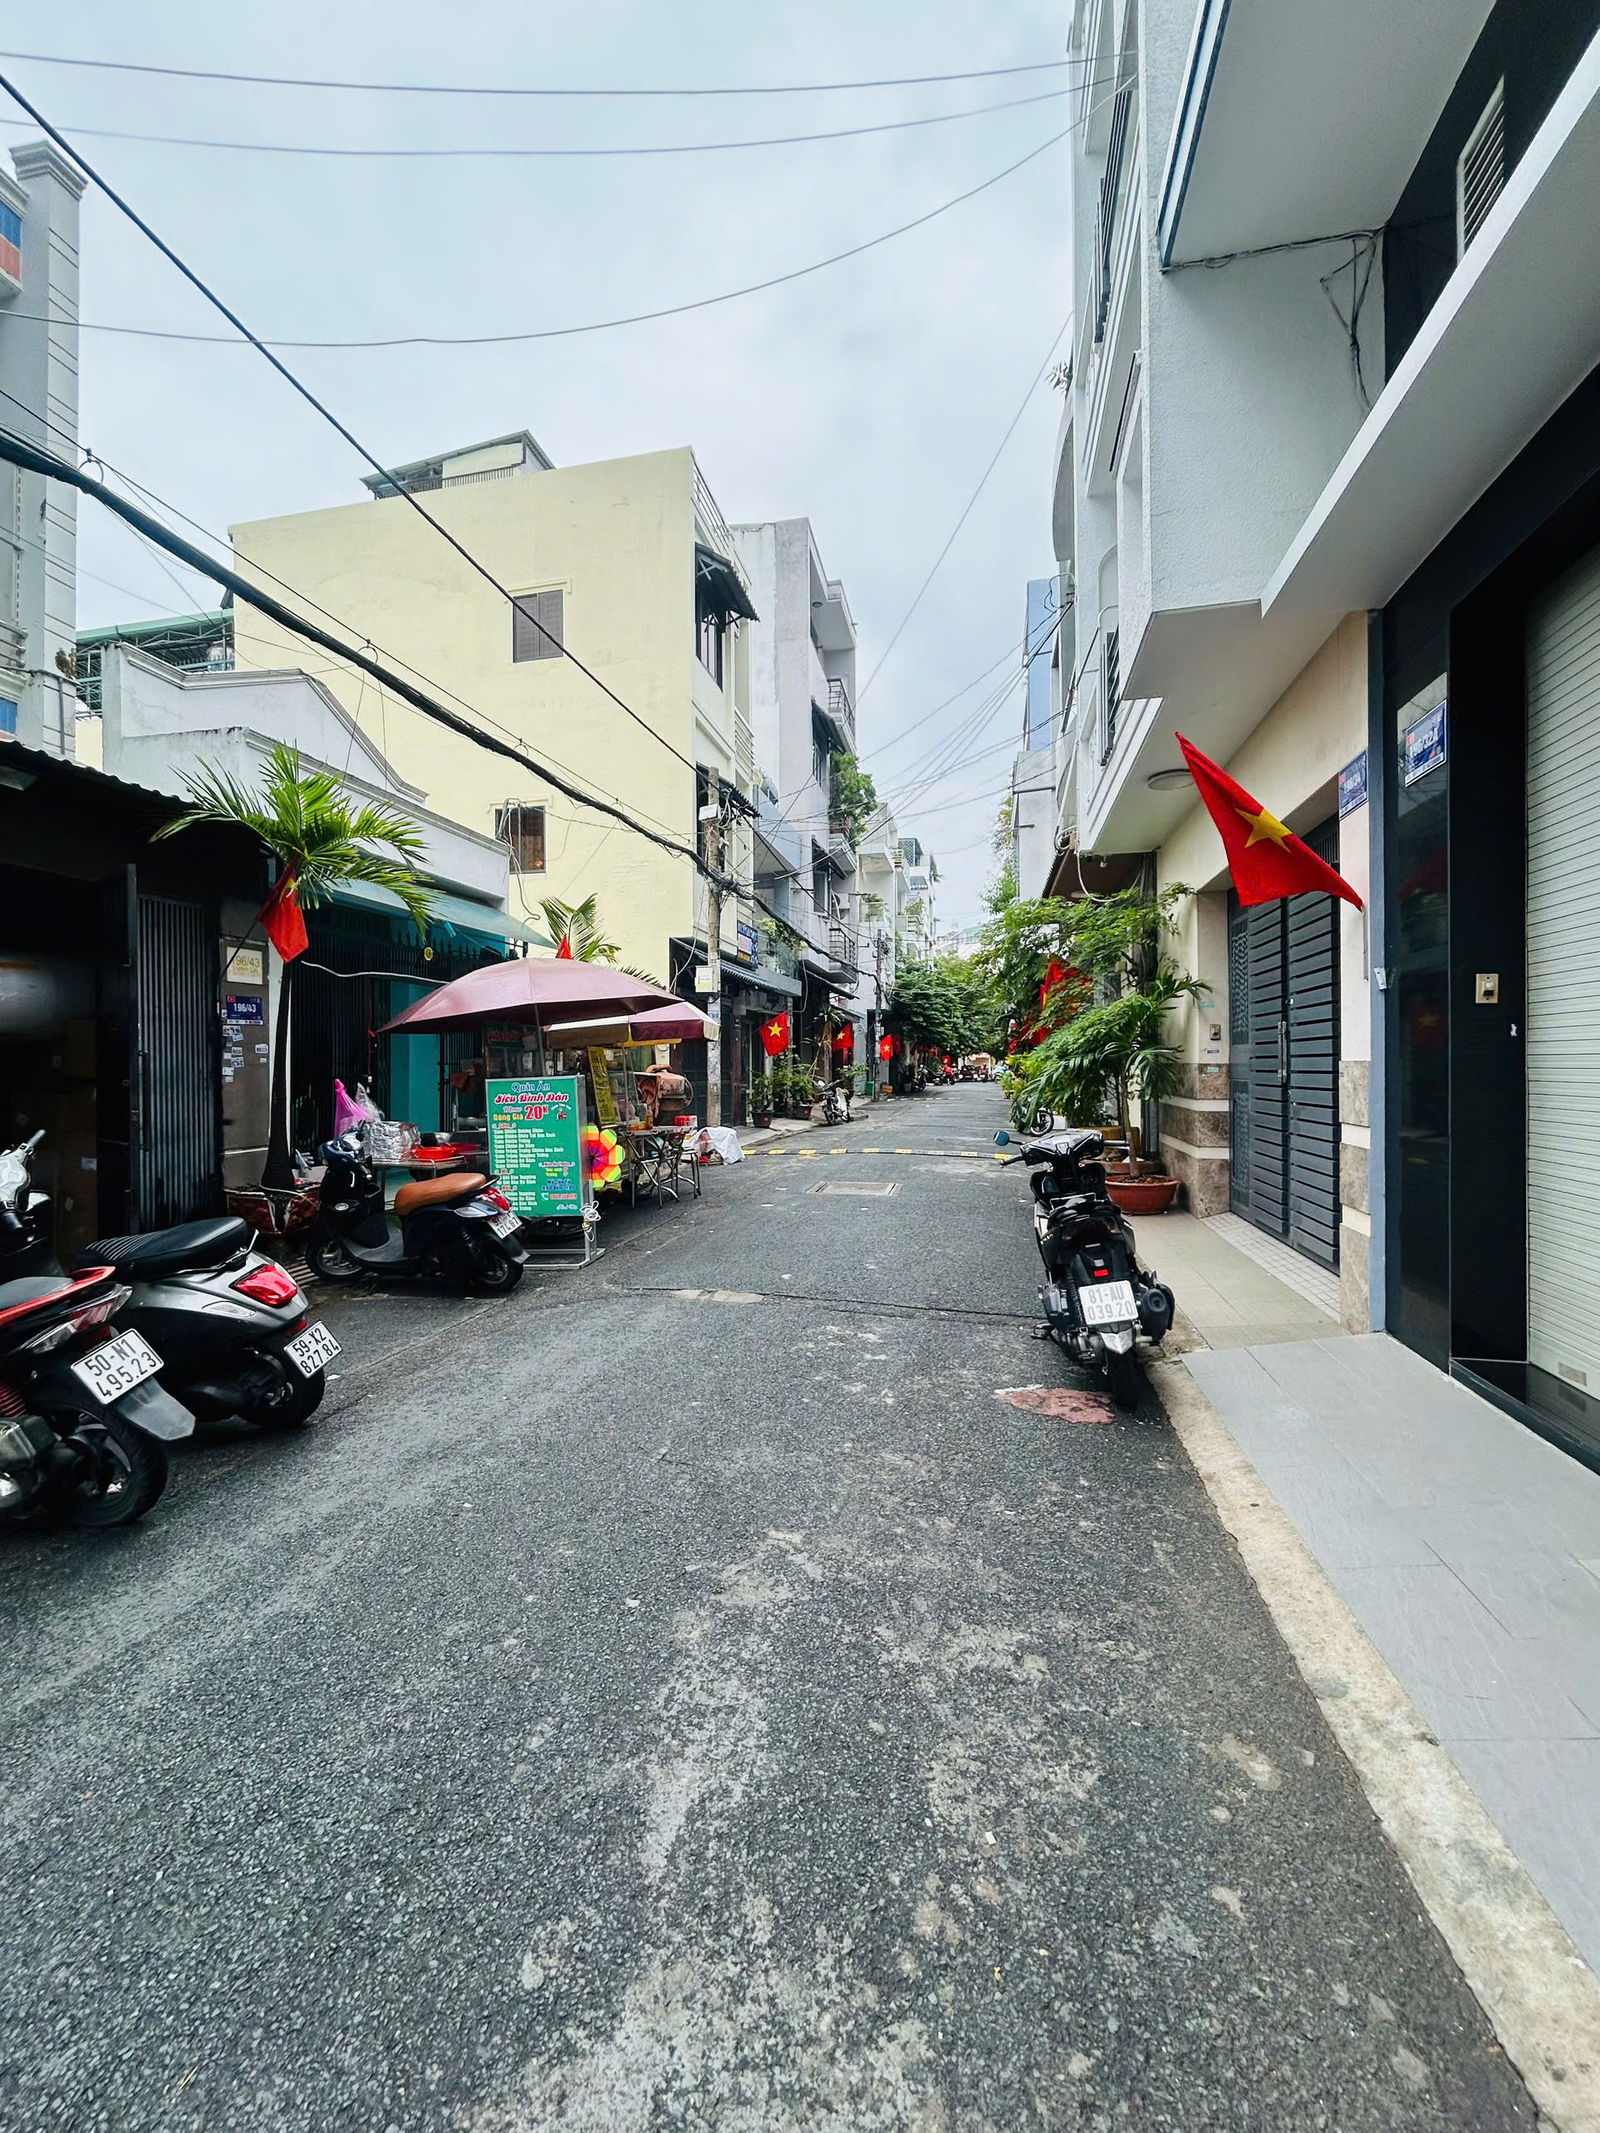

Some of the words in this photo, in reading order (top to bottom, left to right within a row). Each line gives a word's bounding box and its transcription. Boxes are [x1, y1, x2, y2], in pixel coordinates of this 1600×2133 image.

[233, 955, 260, 968] 96/43
[233, 1002, 257, 1013] 196/43
[1088, 1284, 1125, 1304] 81-AU
[1087, 1300, 1134, 1321] 039.20
[292, 1327, 327, 1357] 59-X2
[84, 1338, 136, 1377] 50-N1
[96, 1351, 157, 1397] 495.23
